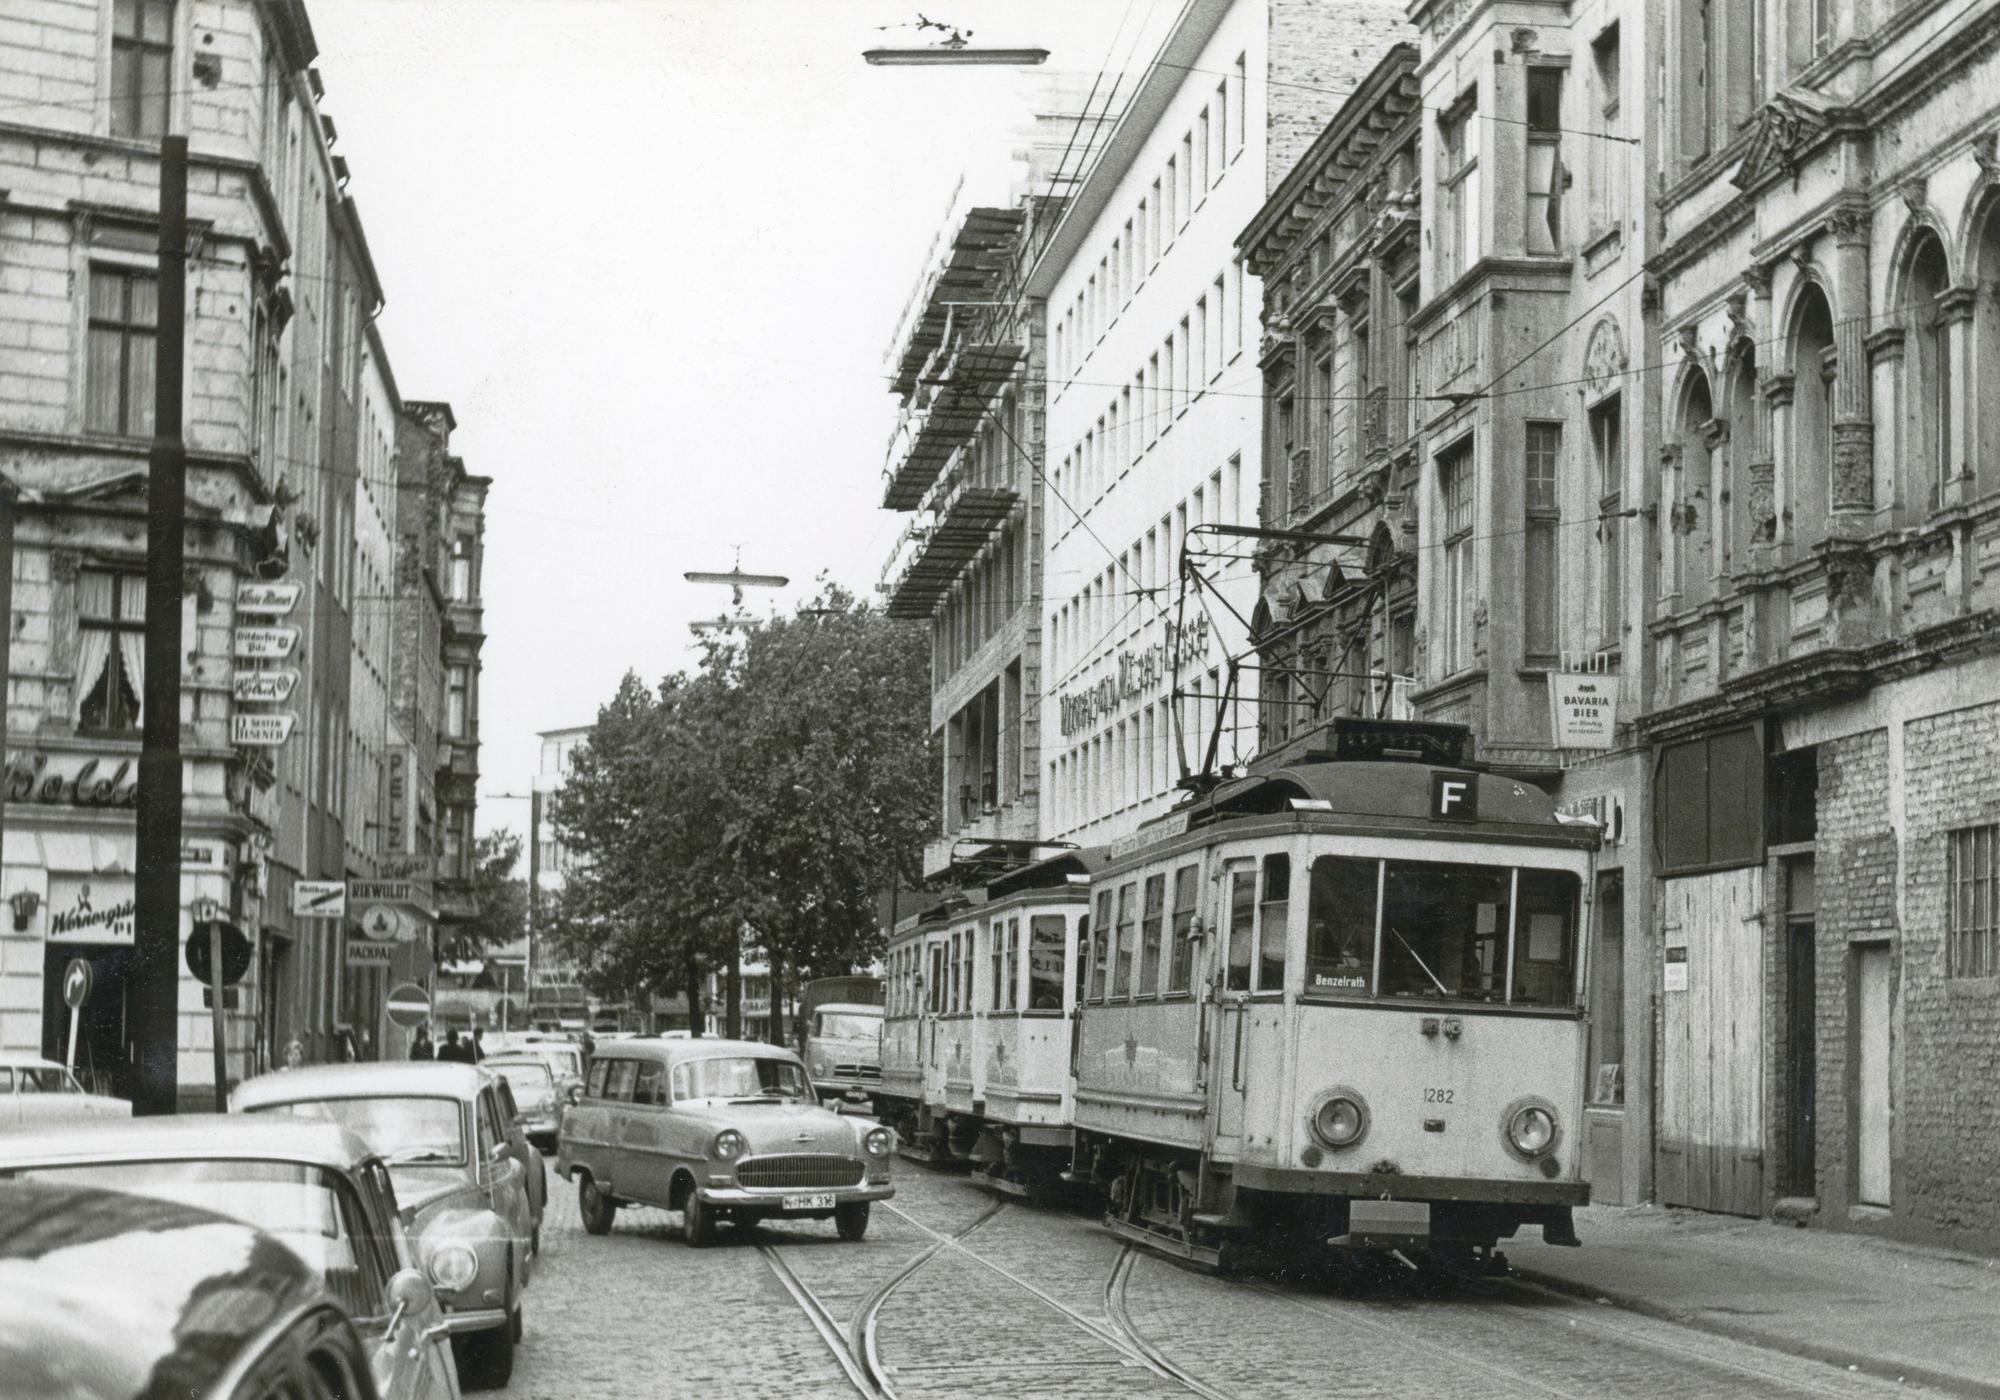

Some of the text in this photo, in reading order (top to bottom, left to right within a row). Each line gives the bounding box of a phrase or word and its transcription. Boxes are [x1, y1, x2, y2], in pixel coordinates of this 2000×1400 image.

[1563, 696, 1609, 706] BAVARIA
[1573, 708, 1599, 718] BIER
[1441, 781, 1467, 814] F
[1315, 973, 1366, 988] Benzelrath
[1423, 1088, 1455, 1104] 1282
